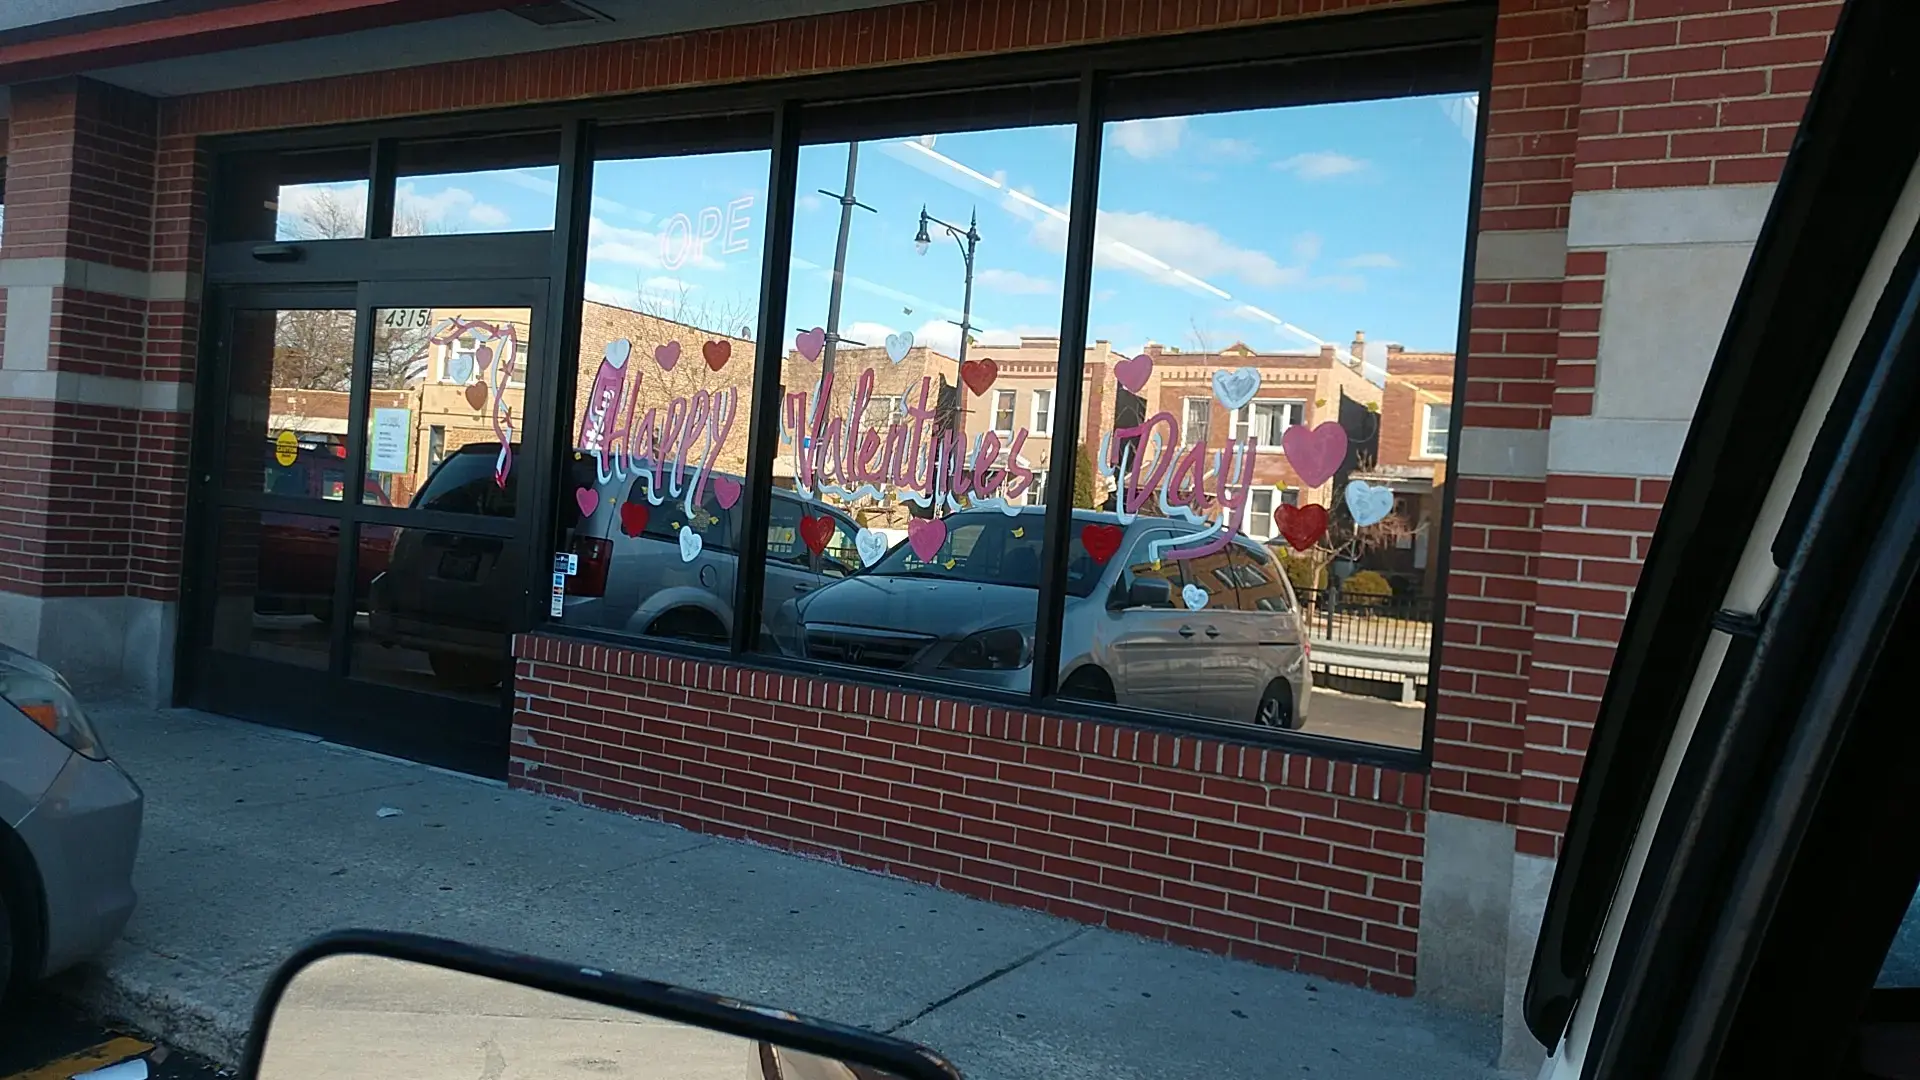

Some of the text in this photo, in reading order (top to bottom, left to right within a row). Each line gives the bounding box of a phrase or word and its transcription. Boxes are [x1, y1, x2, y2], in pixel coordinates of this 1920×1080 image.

[384, 309, 428, 327] 4315
[597, 367, 738, 508] Happy
[786, 367, 1034, 499] Valentines
[1111, 411, 1257, 559] Day
